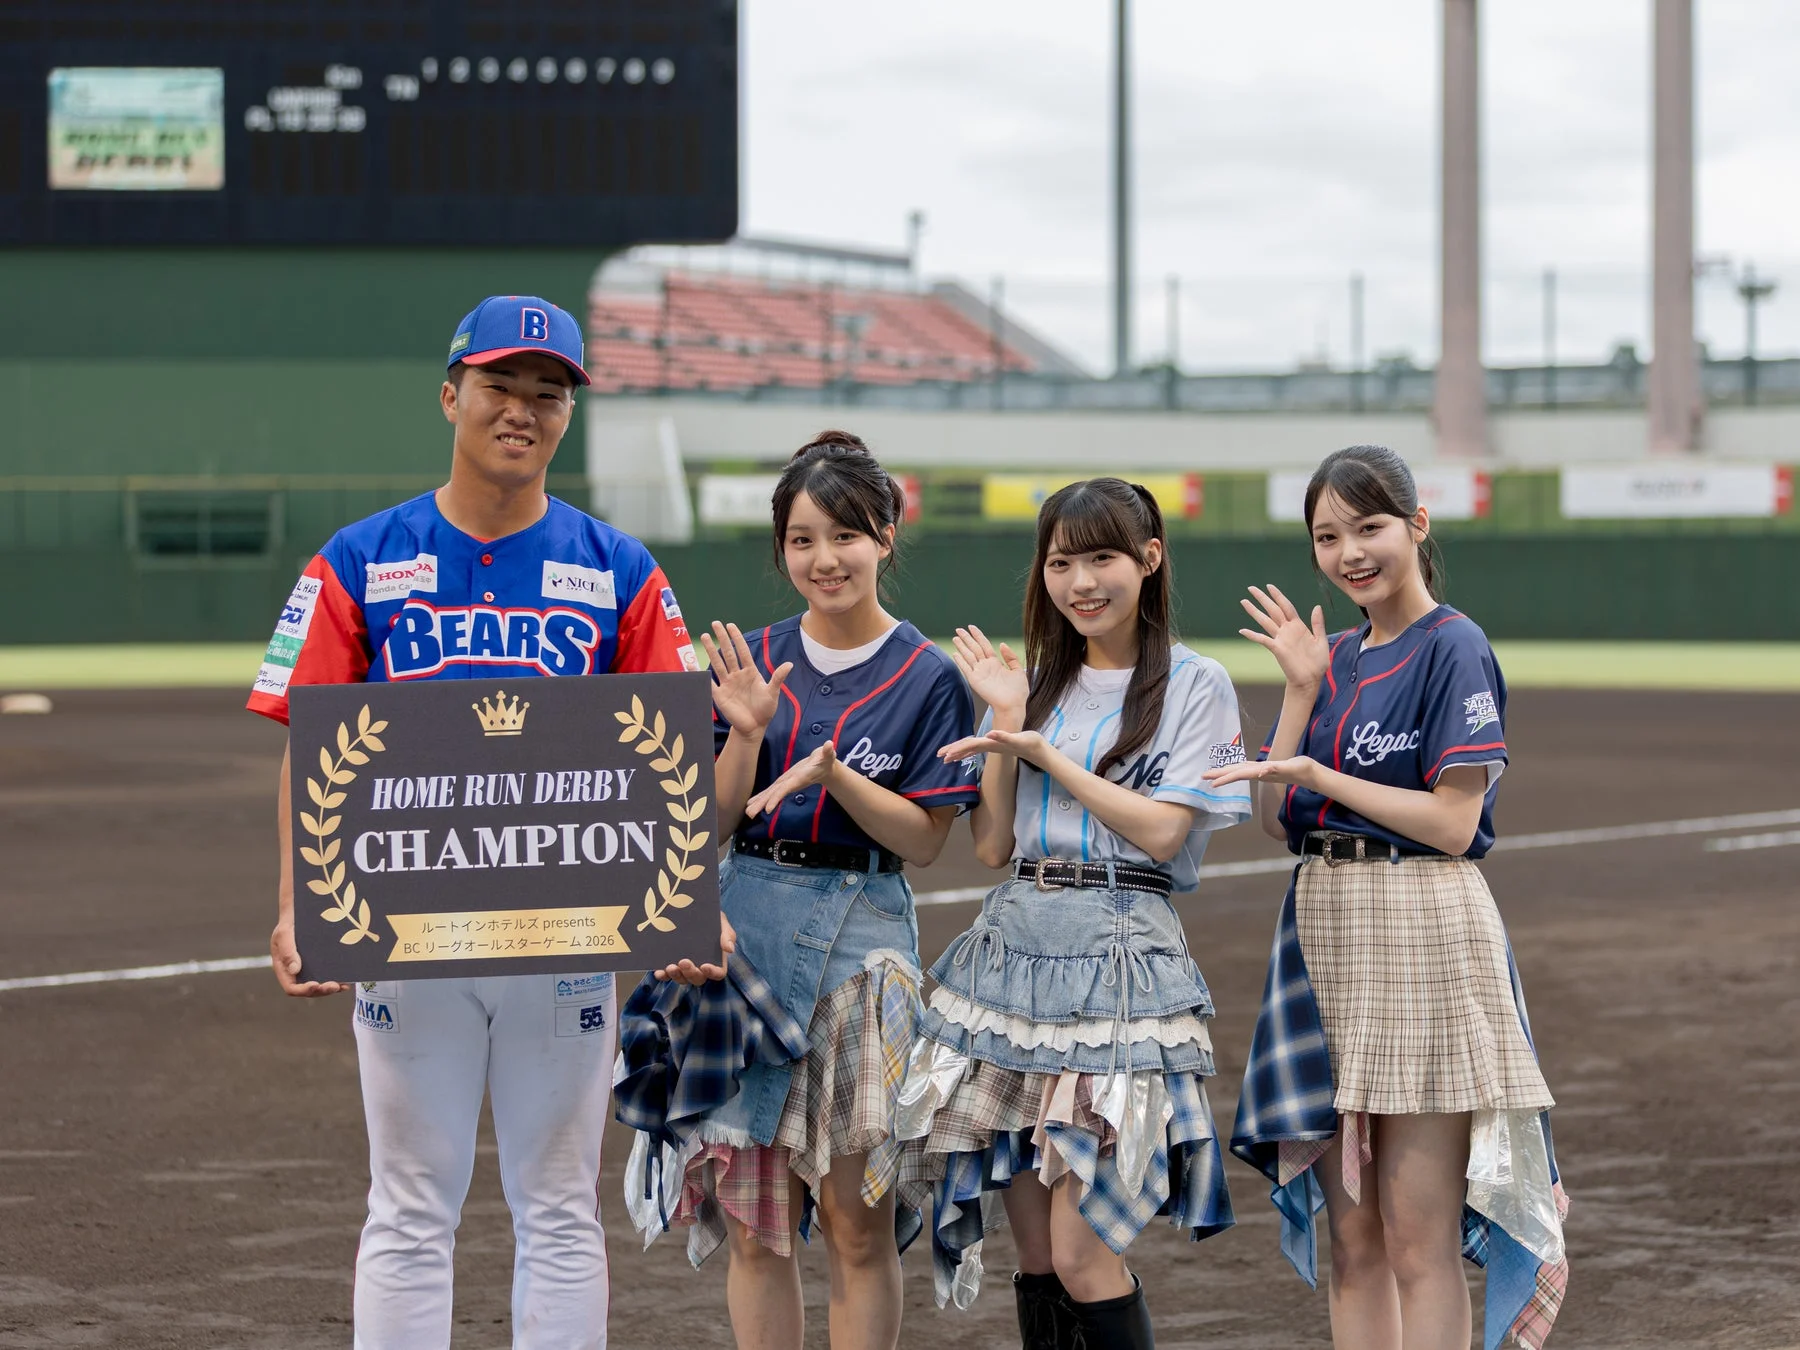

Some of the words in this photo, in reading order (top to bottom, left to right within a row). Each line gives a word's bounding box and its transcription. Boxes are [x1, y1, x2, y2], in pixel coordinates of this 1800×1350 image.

[521, 308, 548, 341] B
[367, 584, 396, 595] Honda
[384, 603, 599, 679] BEARS
[370, 775, 456, 810] HOME
[462, 772, 526, 807] RUN
[532, 768, 636, 804] DERBY
[353, 820, 657, 873] CHAMPION
[421, 916, 539, 935] ルートインホテルズ
[543, 916, 596, 930] presents
[425, 936, 582, 954] リーグオールスターゲーム
[585, 934, 615, 948] 2026
[580, 1005, 603, 1030] 55
